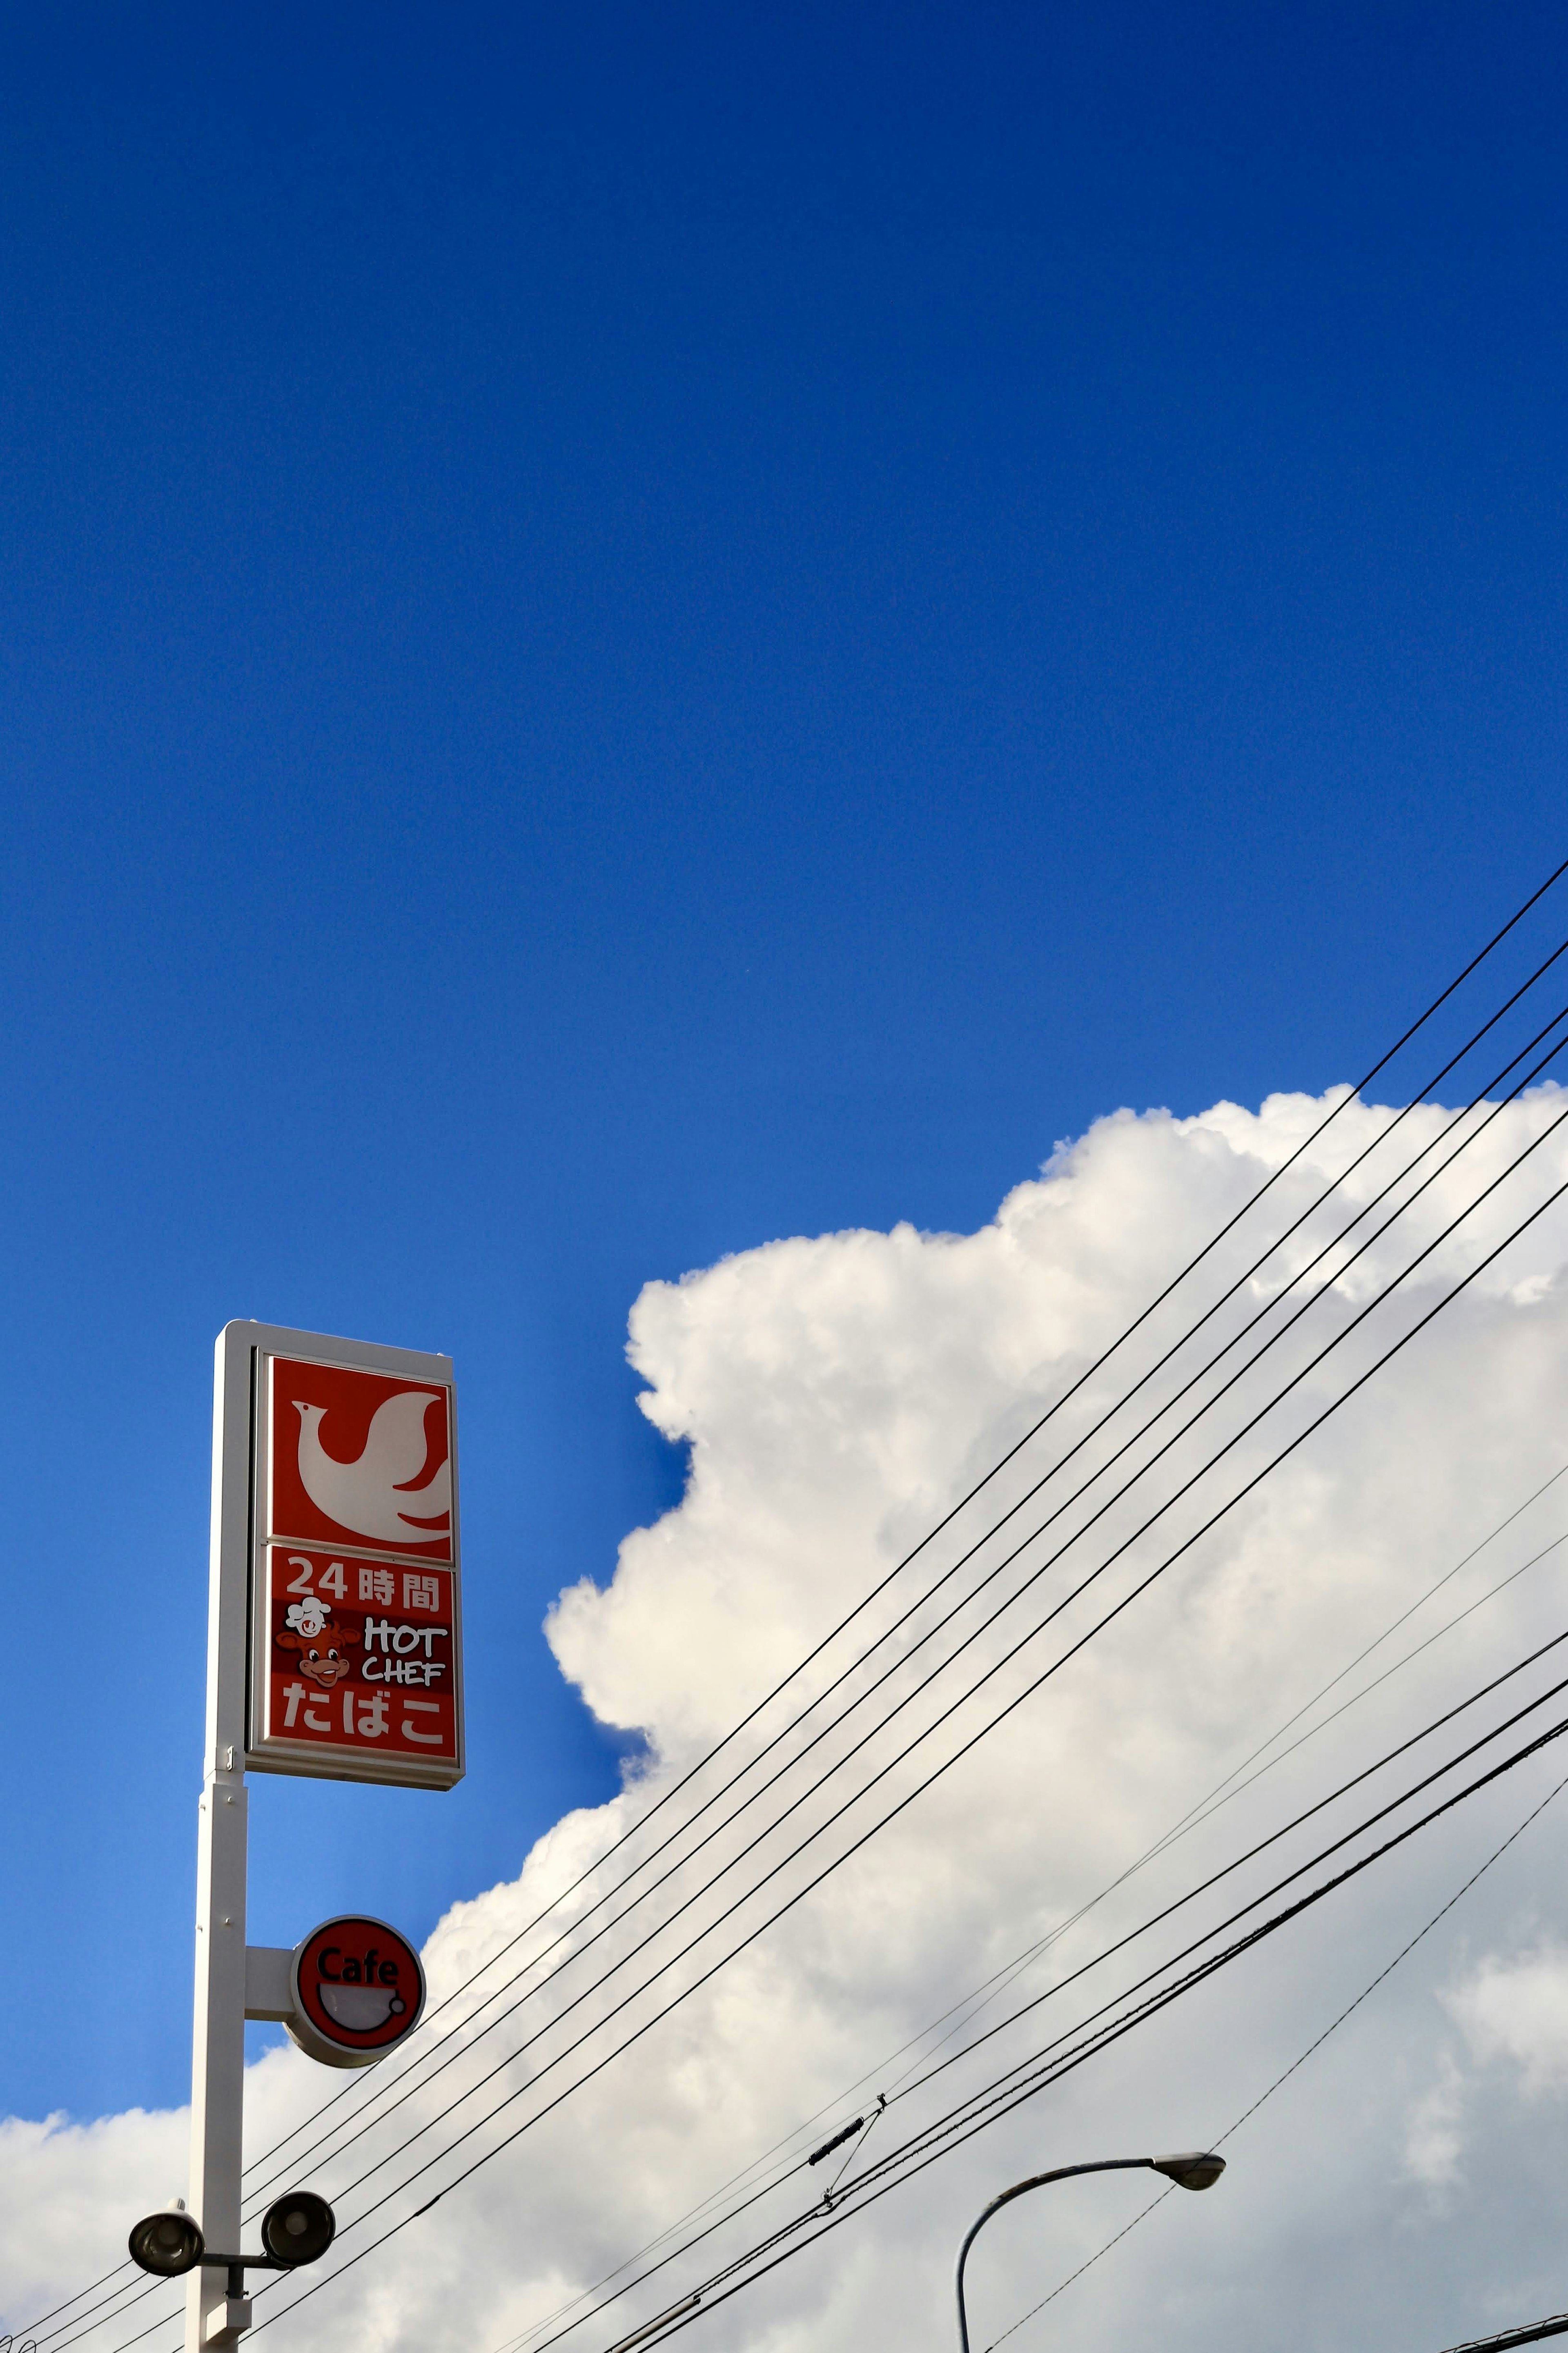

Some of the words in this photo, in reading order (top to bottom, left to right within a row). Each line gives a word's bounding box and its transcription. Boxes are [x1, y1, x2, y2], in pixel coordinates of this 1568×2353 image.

[286, 1556, 439, 1612] 24時間
[365, 1617, 448, 1657] HOT
[362, 1657, 445, 1686] CHEF
[283, 1682, 443, 1744] たばこ
[317, 1947, 399, 1985] Cafe
